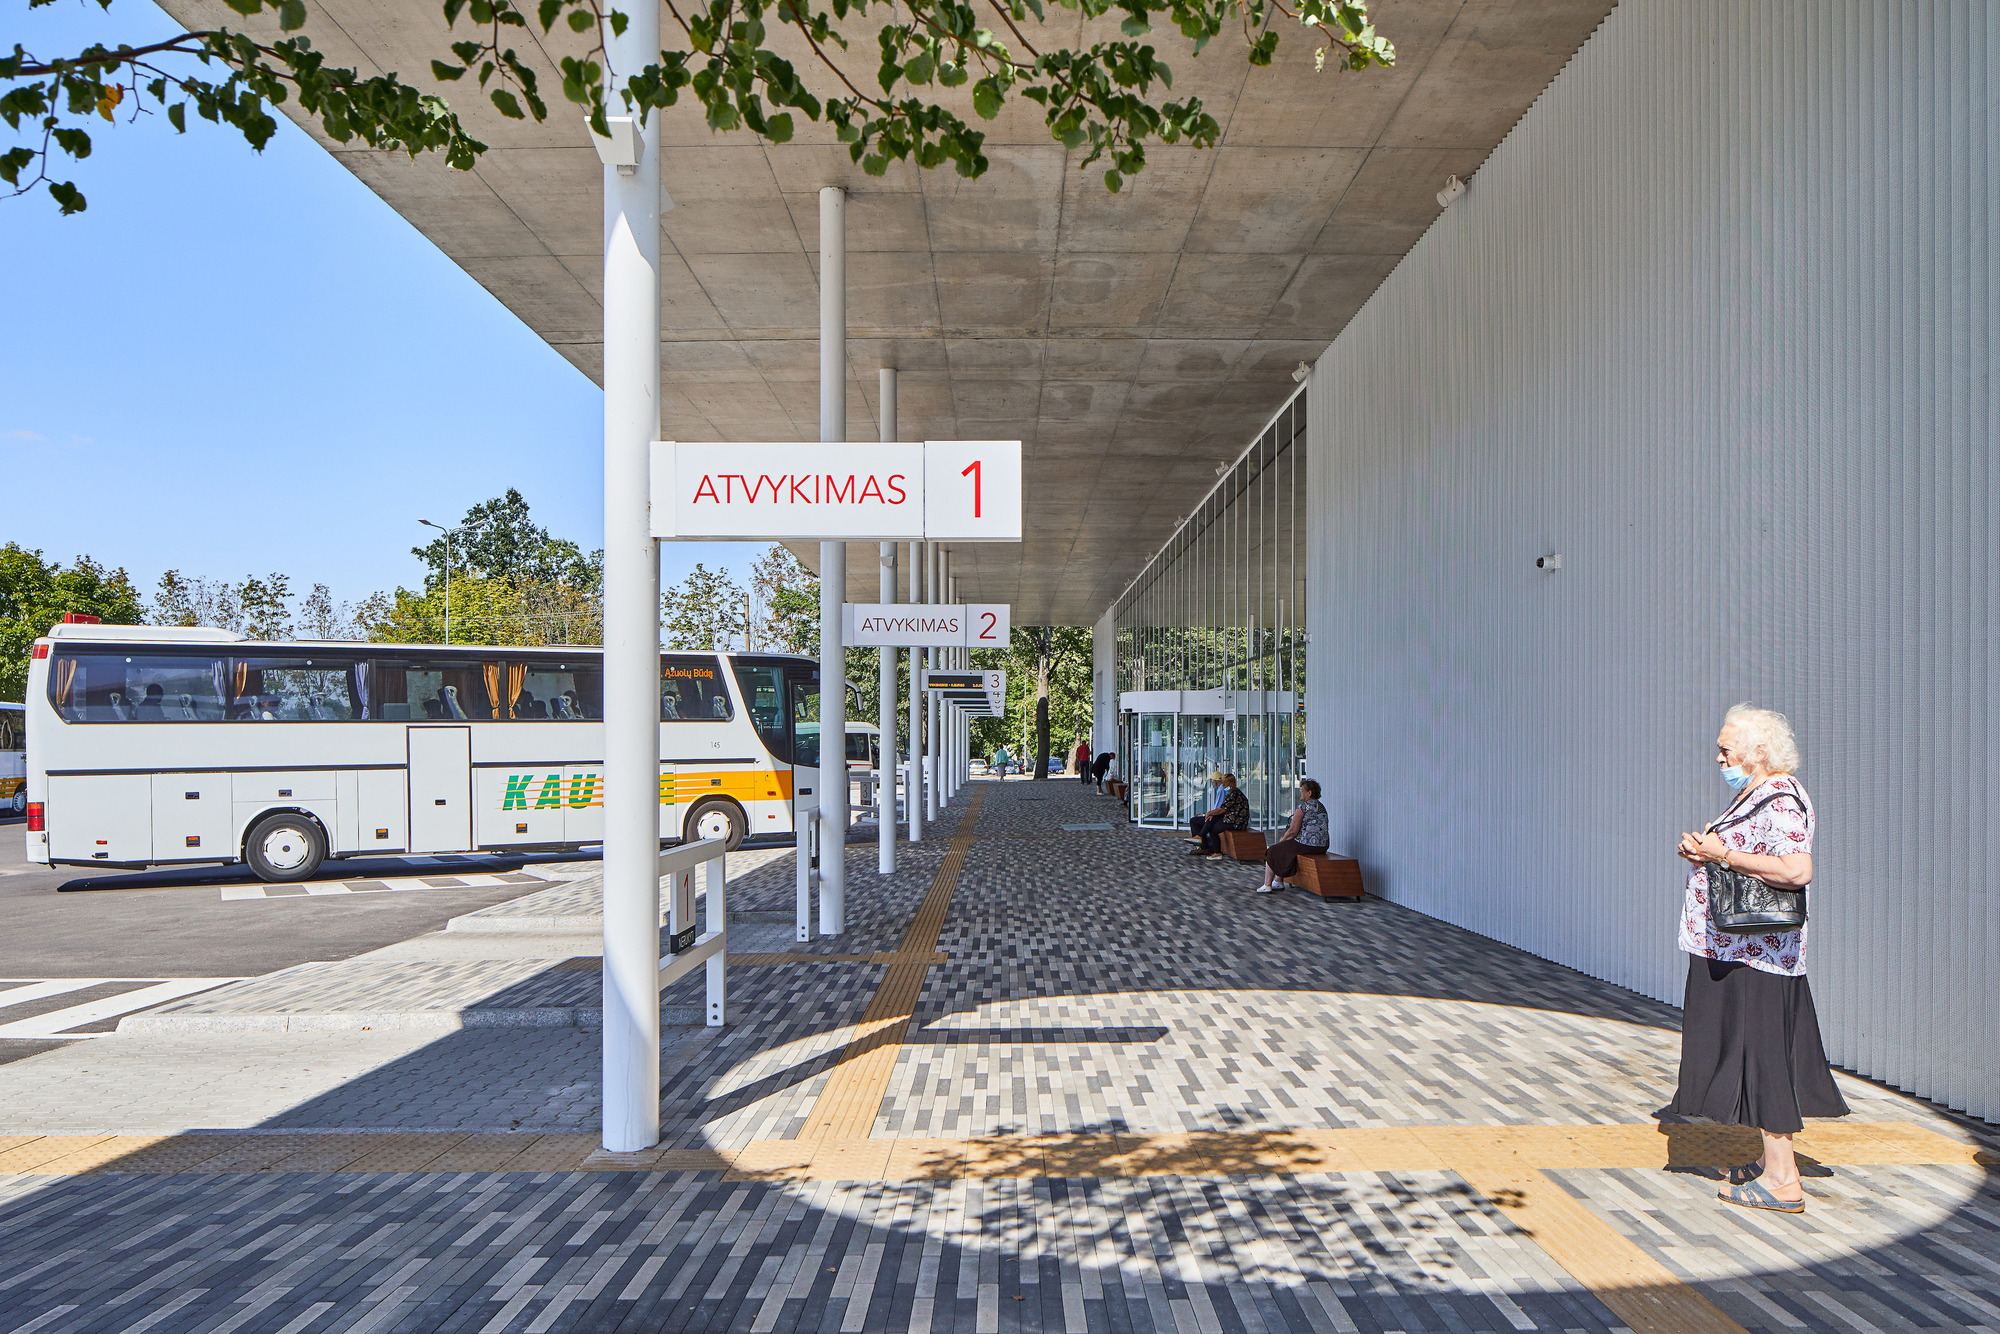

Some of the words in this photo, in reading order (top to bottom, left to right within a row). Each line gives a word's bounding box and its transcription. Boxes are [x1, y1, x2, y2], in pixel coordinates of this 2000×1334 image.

[692, 474, 907, 505] ATVYKIMAS
[961, 460, 982, 519] 1
[861, 617, 959, 633] ATVYKIMAS
[979, 612, 997, 640] 2
[990, 673, 1000, 689] 3
[710, 741, 721, 749] 145
[683, 873, 689, 922] 1
